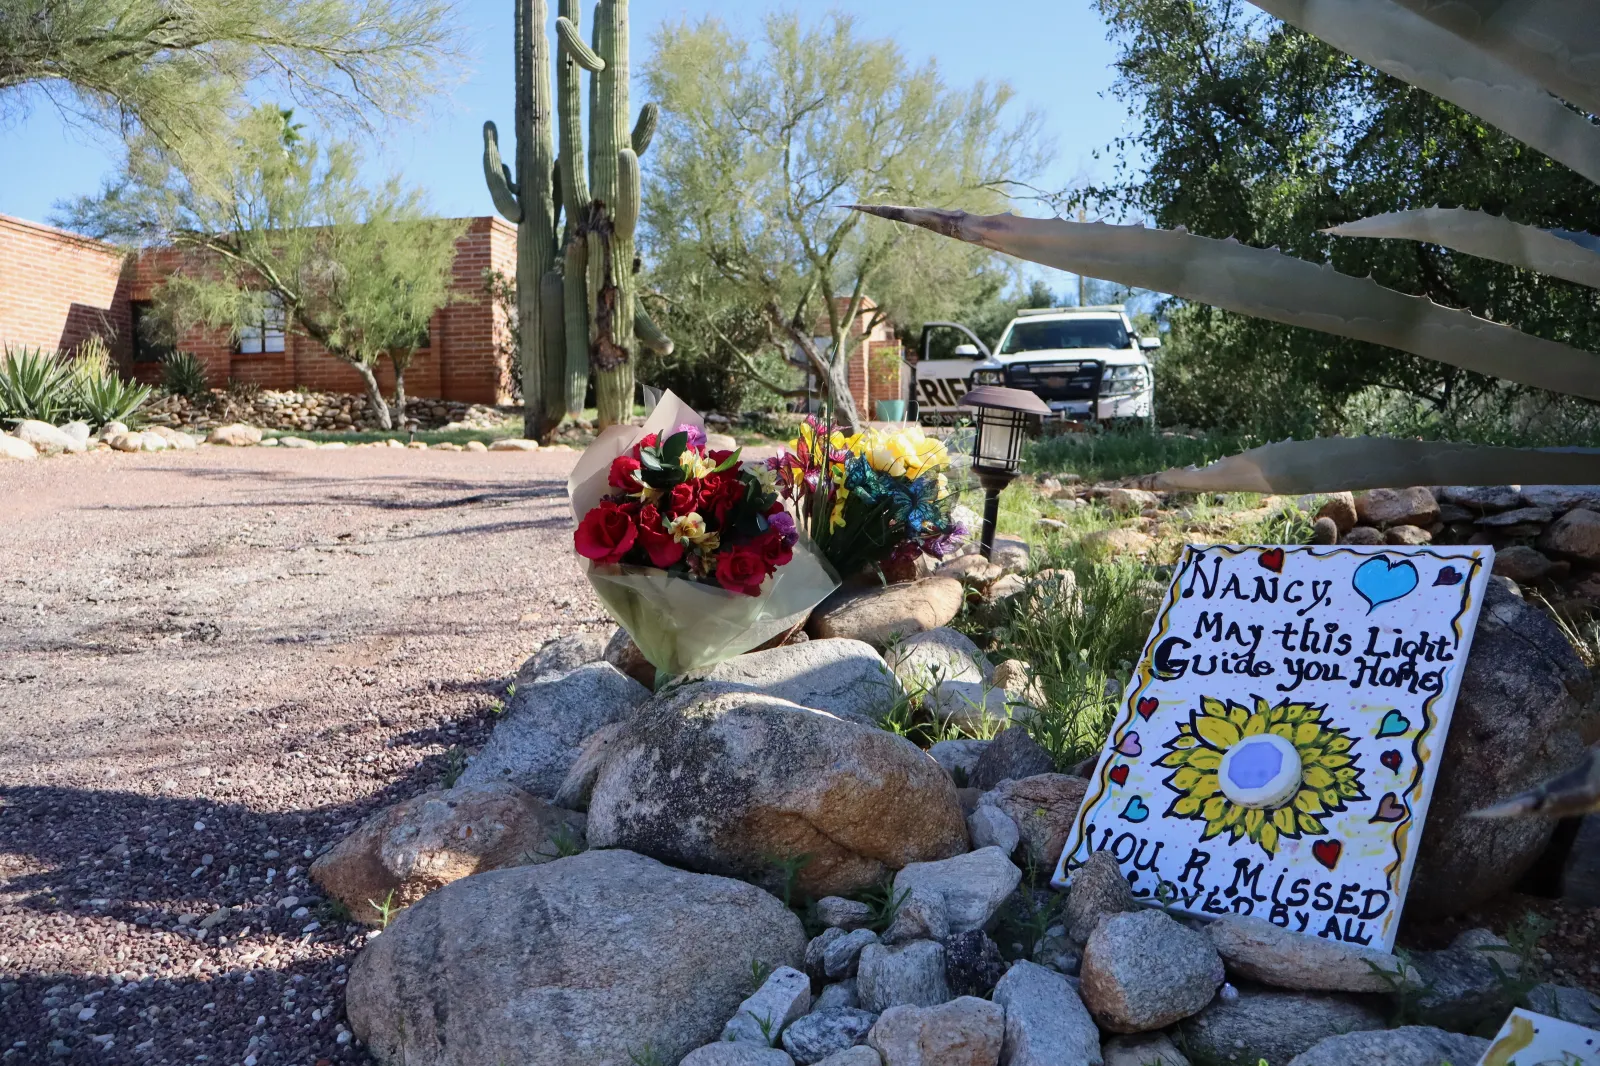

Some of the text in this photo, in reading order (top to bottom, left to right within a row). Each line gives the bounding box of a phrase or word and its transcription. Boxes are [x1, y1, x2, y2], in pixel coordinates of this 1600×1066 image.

[1272, 617, 1352, 656] this
[1363, 626, 1454, 674] Light
[1276, 657, 1347, 691] you
[1349, 656, 1443, 694] Home
[1178, 848, 1210, 892] R
[1317, 915, 1373, 946] ALL
